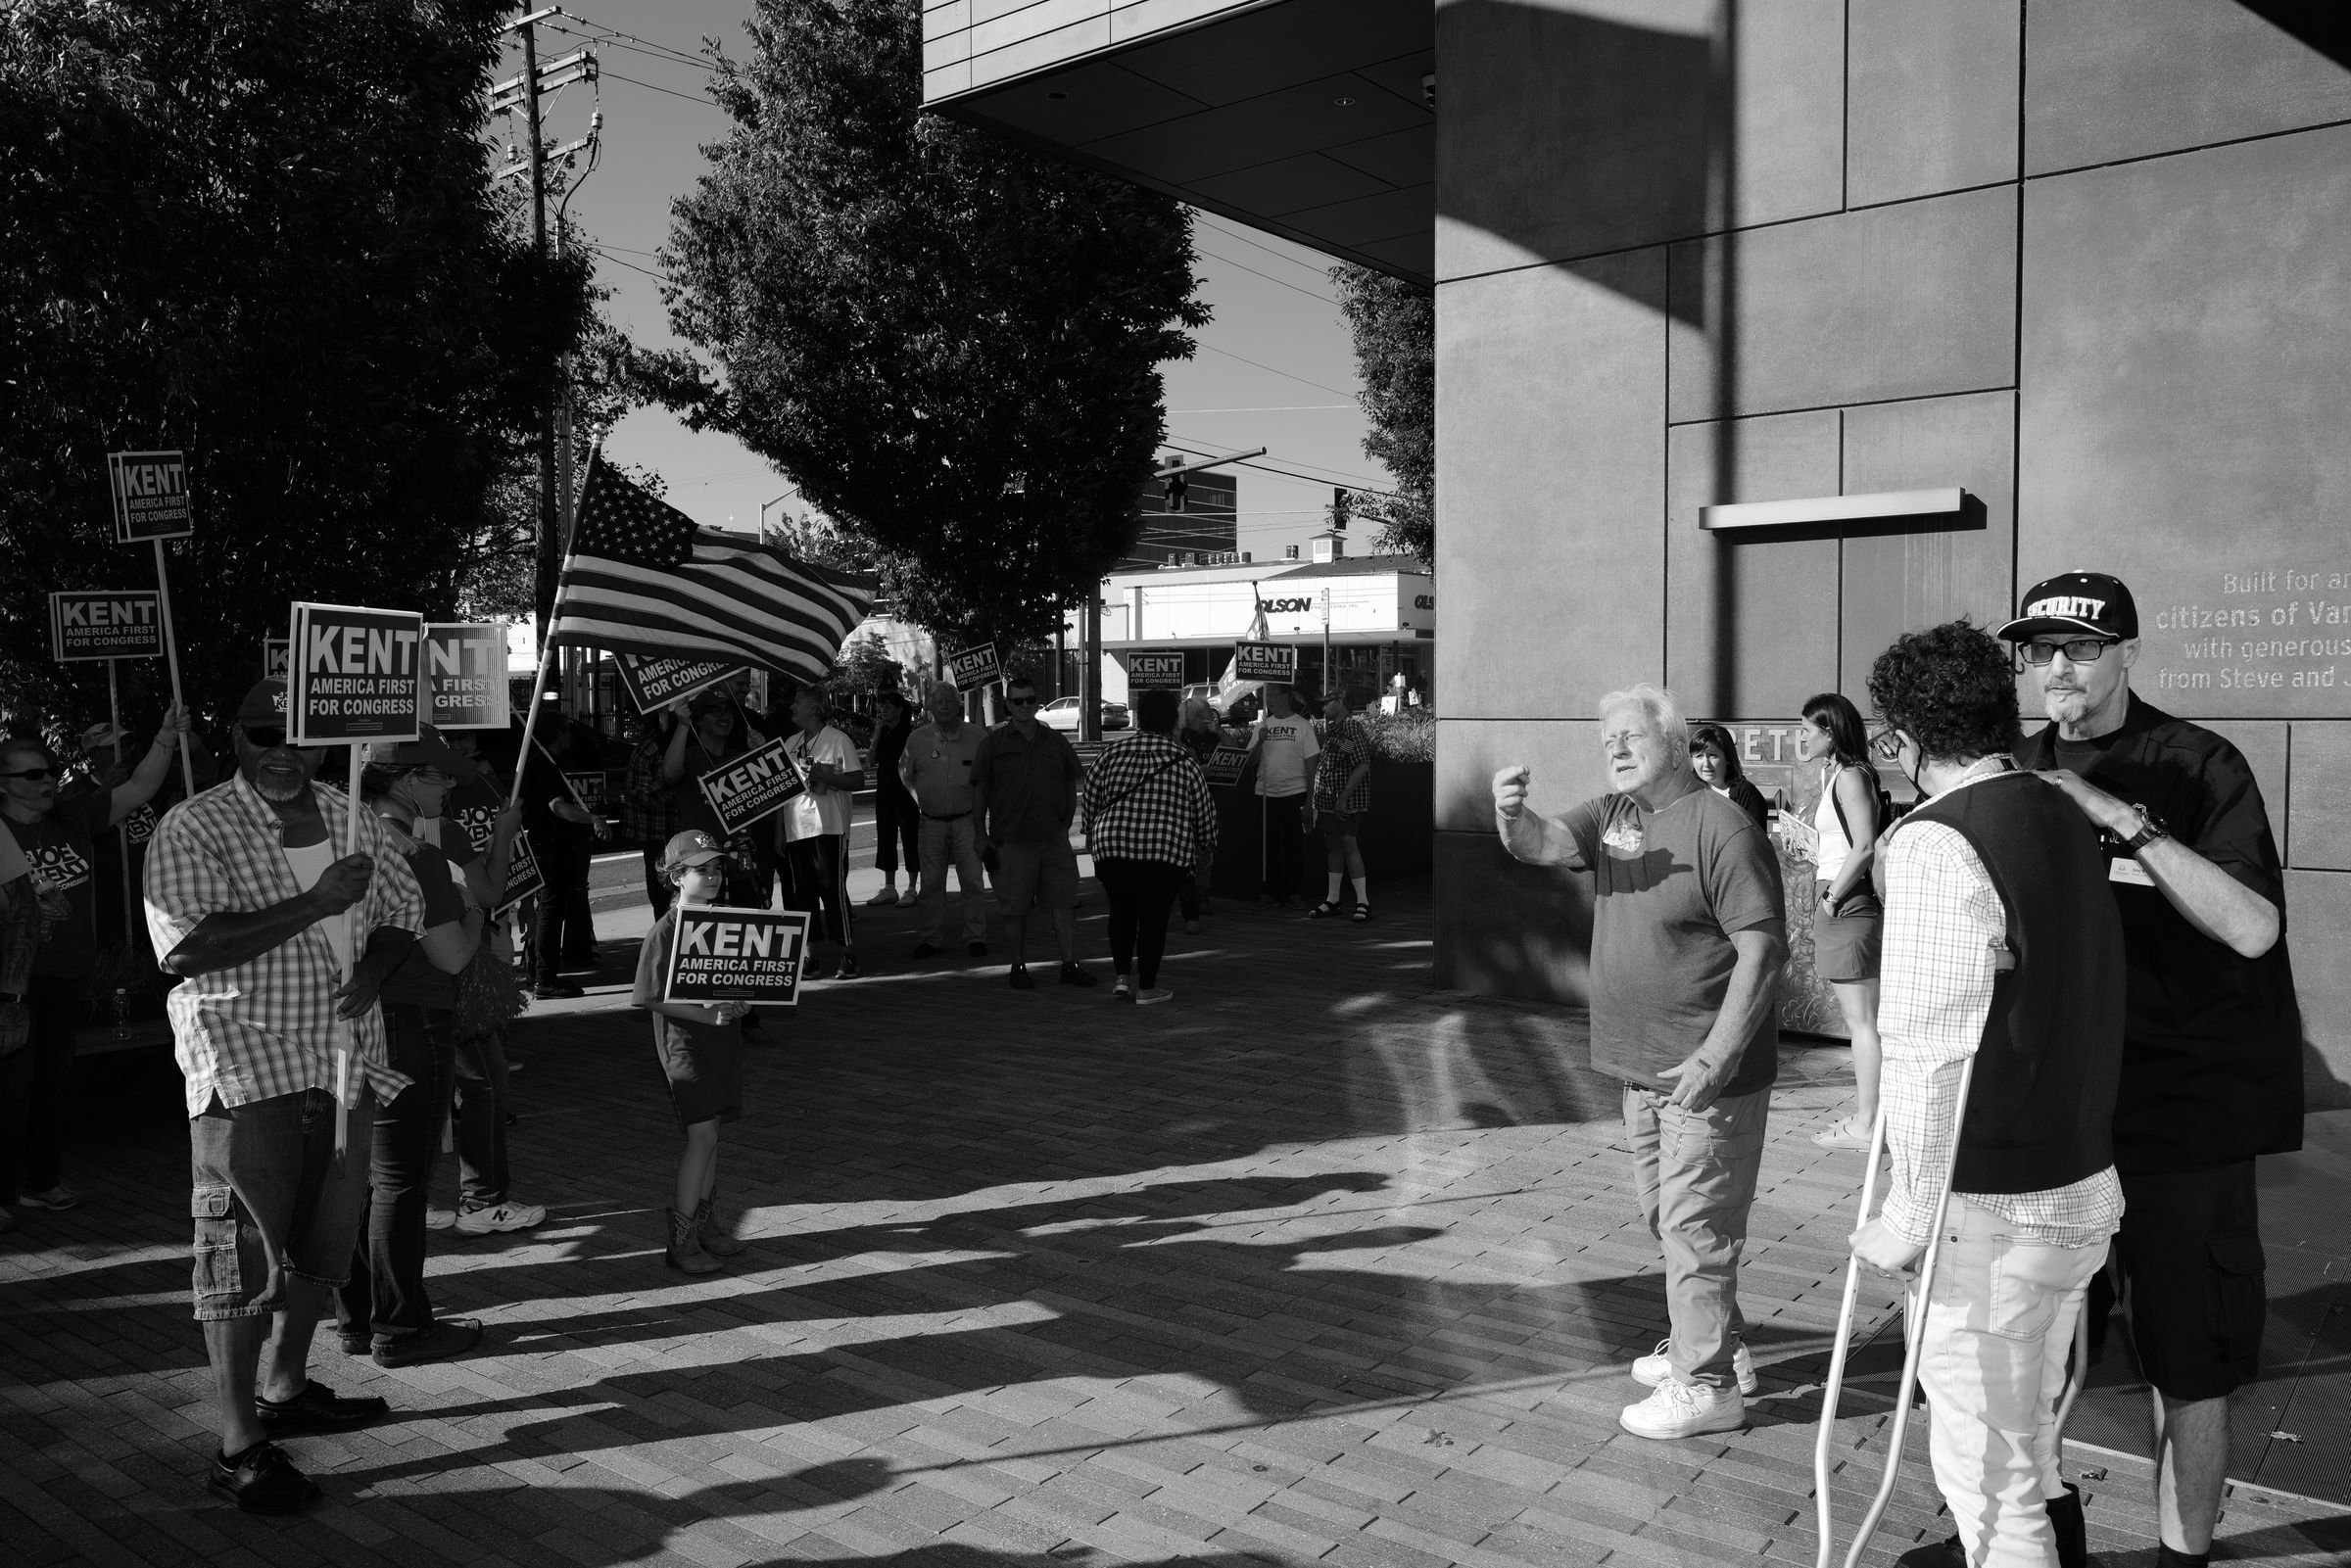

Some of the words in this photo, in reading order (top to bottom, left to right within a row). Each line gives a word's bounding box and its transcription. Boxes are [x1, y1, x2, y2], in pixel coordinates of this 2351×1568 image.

[124, 463, 182, 497] KENT
[129, 498, 164, 509] AMERICA
[165, 496, 185, 507] FIRST
[130, 511, 147, 524] FOR
[148, 508, 187, 522] CONGRESS
[2224, 571, 2277, 594] Built
[2285, 569, 2320, 591] for
[62, 600, 156, 626] KENT
[2027, 595, 2106, 621] SECURITY
[2156, 604, 2261, 630] citizens
[2271, 600, 2299, 627] of
[66, 626, 120, 637] AMERICA
[122, 625, 157, 635] FIRST
[66, 638, 90, 647] FOR
[93, 635, 157, 646] CONGRESS
[309, 624, 418, 675] KENT
[1237, 645, 1292, 663] KENT
[2183, 637, 2232, 659] with
[951, 647, 993, 675] KENT
[1129, 657, 1181, 673] KENT
[311, 678, 375, 694] AMERICA
[378, 679, 415, 694] FIRST
[2159, 667, 2211, 689] from
[2220, 667, 2283, 689] Steve
[2291, 665, 2335, 688] and
[643, 678, 673, 700] FOR
[309, 698, 340, 716] FOR
[343, 698, 414, 715] CONGRESS
[1211, 751, 1248, 767] KENT
[707, 746, 786, 804] KENT
[721, 784, 766, 812] AMERICA
[765, 768, 794, 788] FIRST
[724, 804, 746, 821] FOR
[745, 777, 798, 809] CONGRESS
[510, 855, 532, 874] FIRST
[679, 920, 802, 959] KENT
[679, 957, 749, 972] AMERICA
[752, 959, 796, 973] FIRST
[676, 972, 708, 984] FOR
[711, 974, 793, 987] CONGRESS
